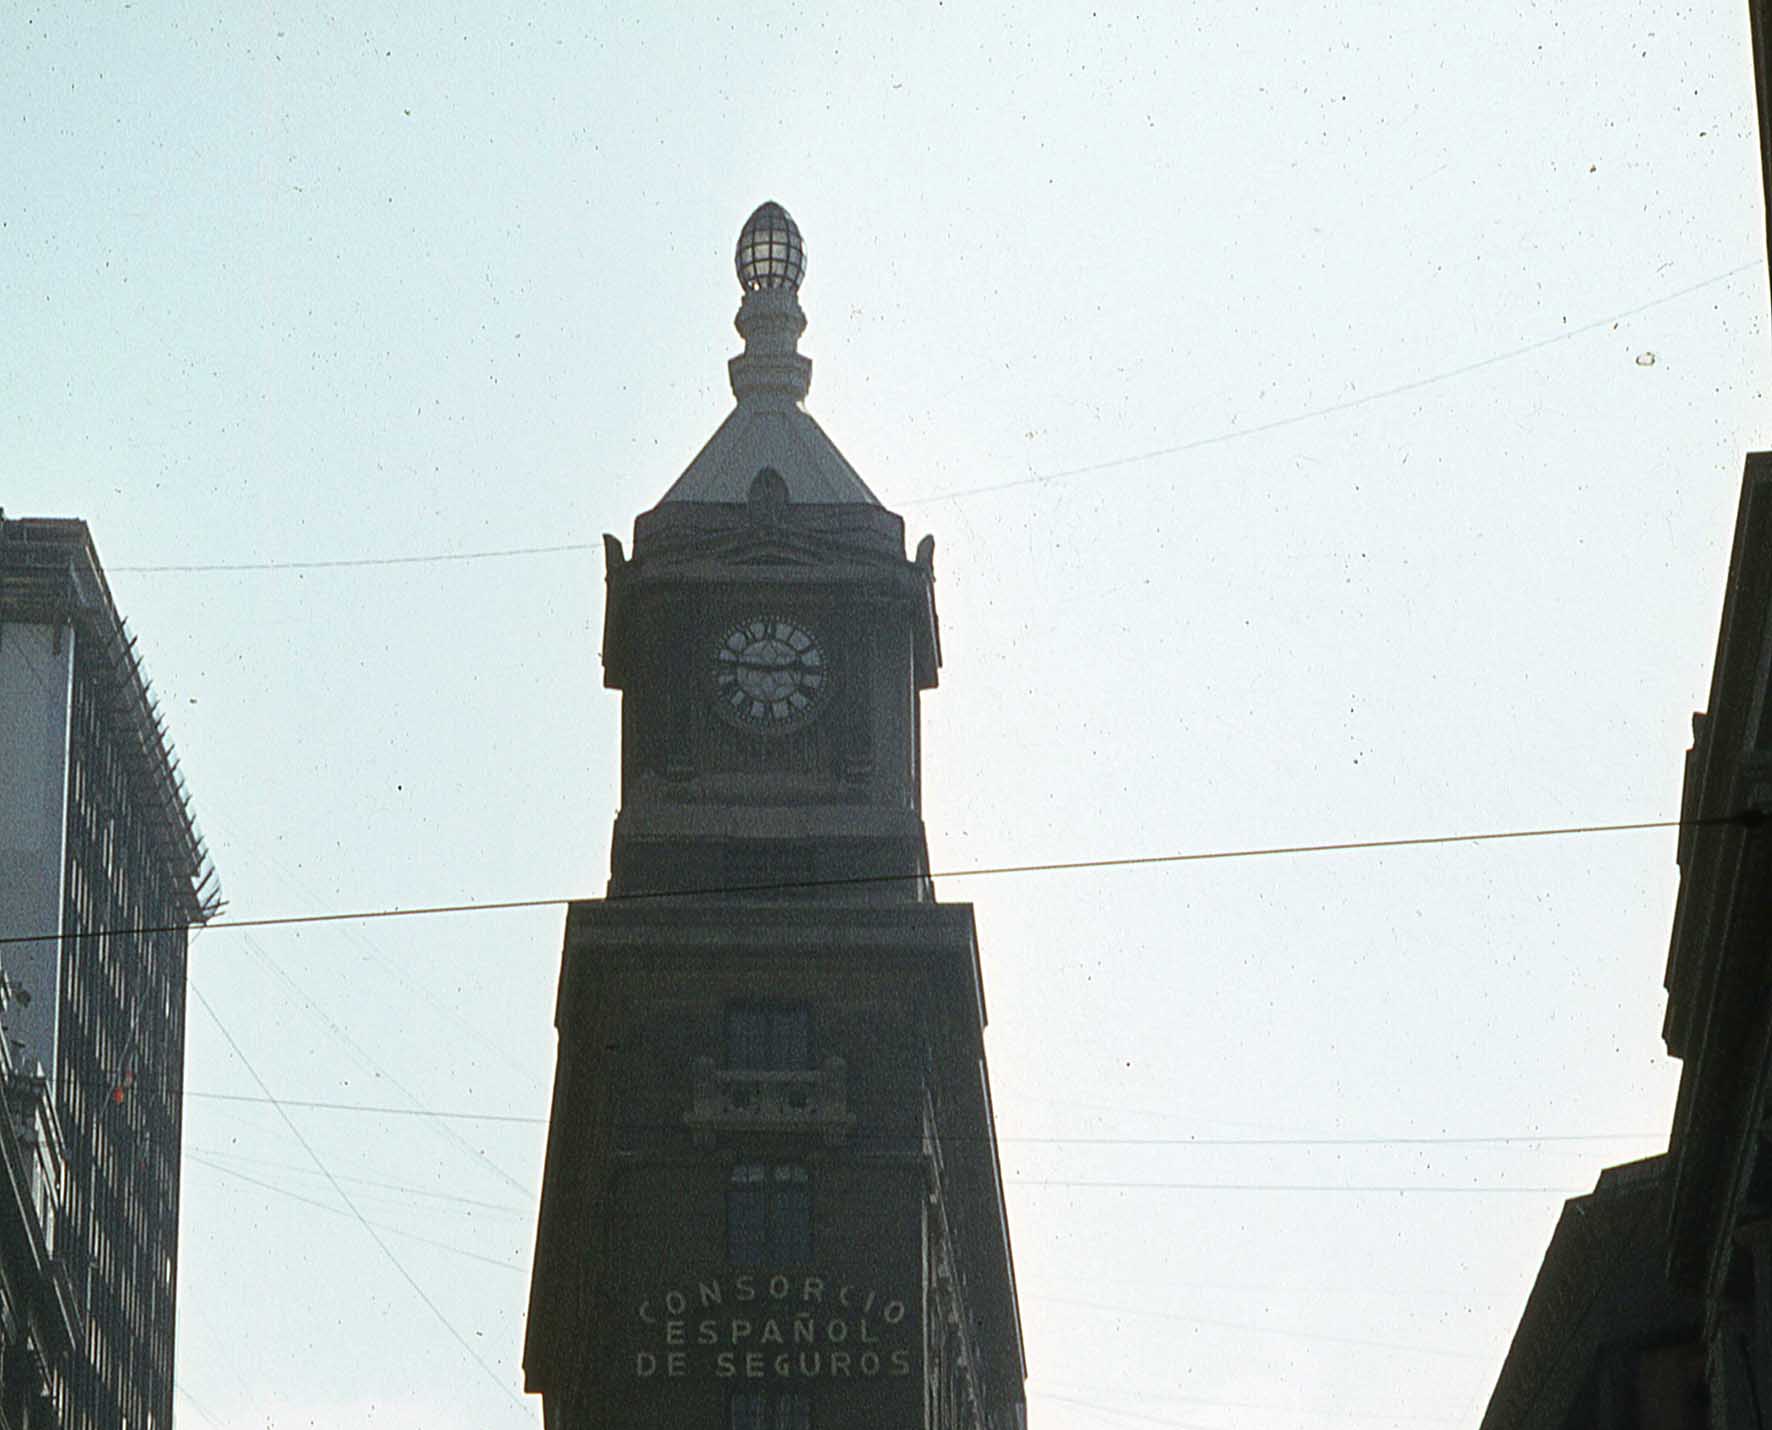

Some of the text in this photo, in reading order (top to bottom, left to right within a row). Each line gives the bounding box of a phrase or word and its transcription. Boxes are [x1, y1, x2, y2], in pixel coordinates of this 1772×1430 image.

[639, 1274, 905, 1324] CONSORCIO
[666, 1312, 880, 1345] ESPAÑOL
[636, 1350, 911, 1378] DE SEGUROS
